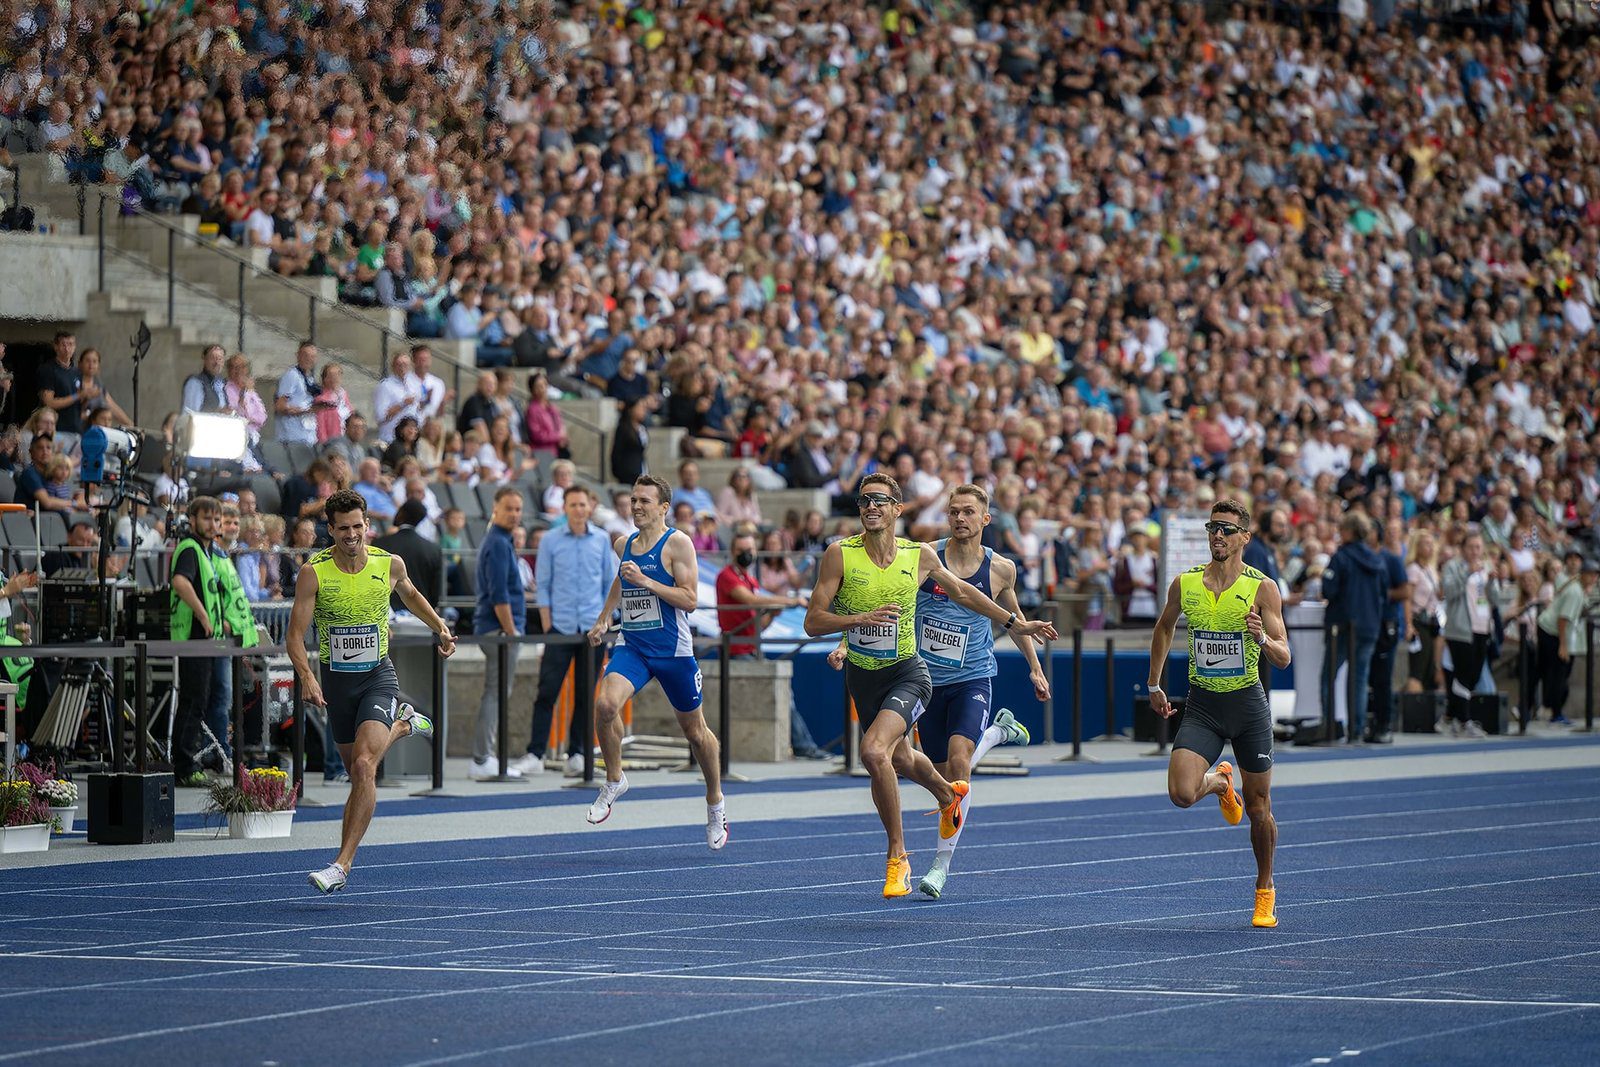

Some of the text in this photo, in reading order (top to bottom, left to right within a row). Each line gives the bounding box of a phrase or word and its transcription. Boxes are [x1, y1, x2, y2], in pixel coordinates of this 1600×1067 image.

[625, 599, 652, 611] JUNKER
[334, 635, 375, 650] J. BORLÉE
[924, 628, 961, 647] SCHLEGEL
[1197, 641, 1239, 656] K. BORLÉE
